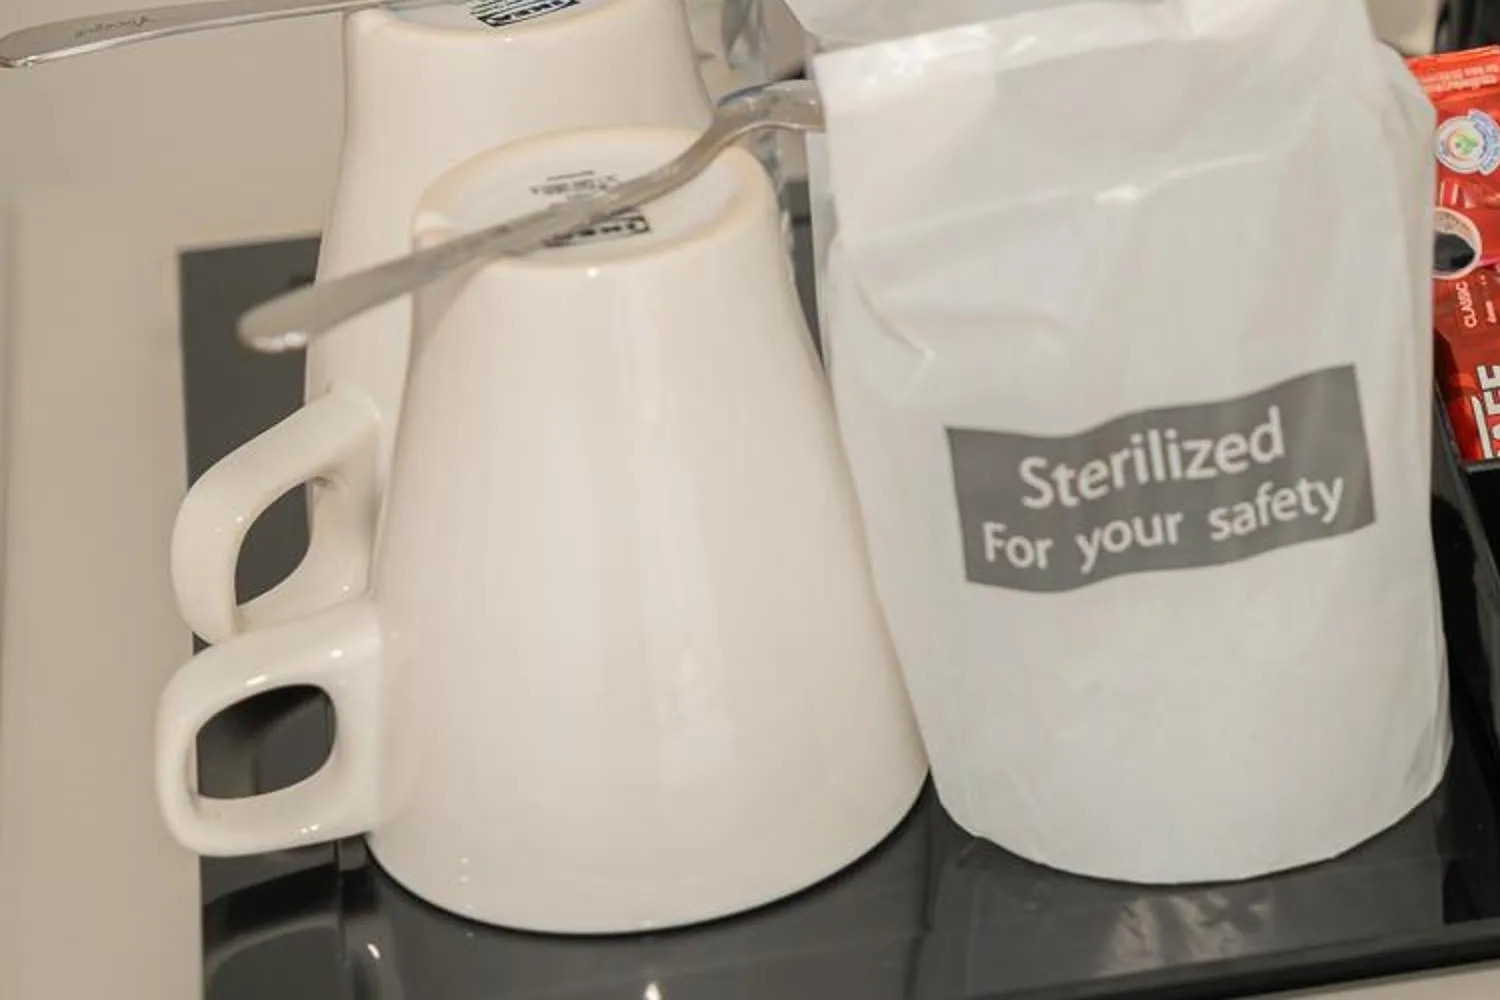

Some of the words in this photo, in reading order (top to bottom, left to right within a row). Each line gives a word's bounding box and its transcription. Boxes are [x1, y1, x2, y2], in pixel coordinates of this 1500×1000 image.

[1455, 280, 1478, 330] CLASSIC
[1018, 405, 1287, 510] Sterilized
[982, 521, 1054, 569] For
[1074, 511, 1184, 574] your
[1208, 476, 1344, 541] safety
